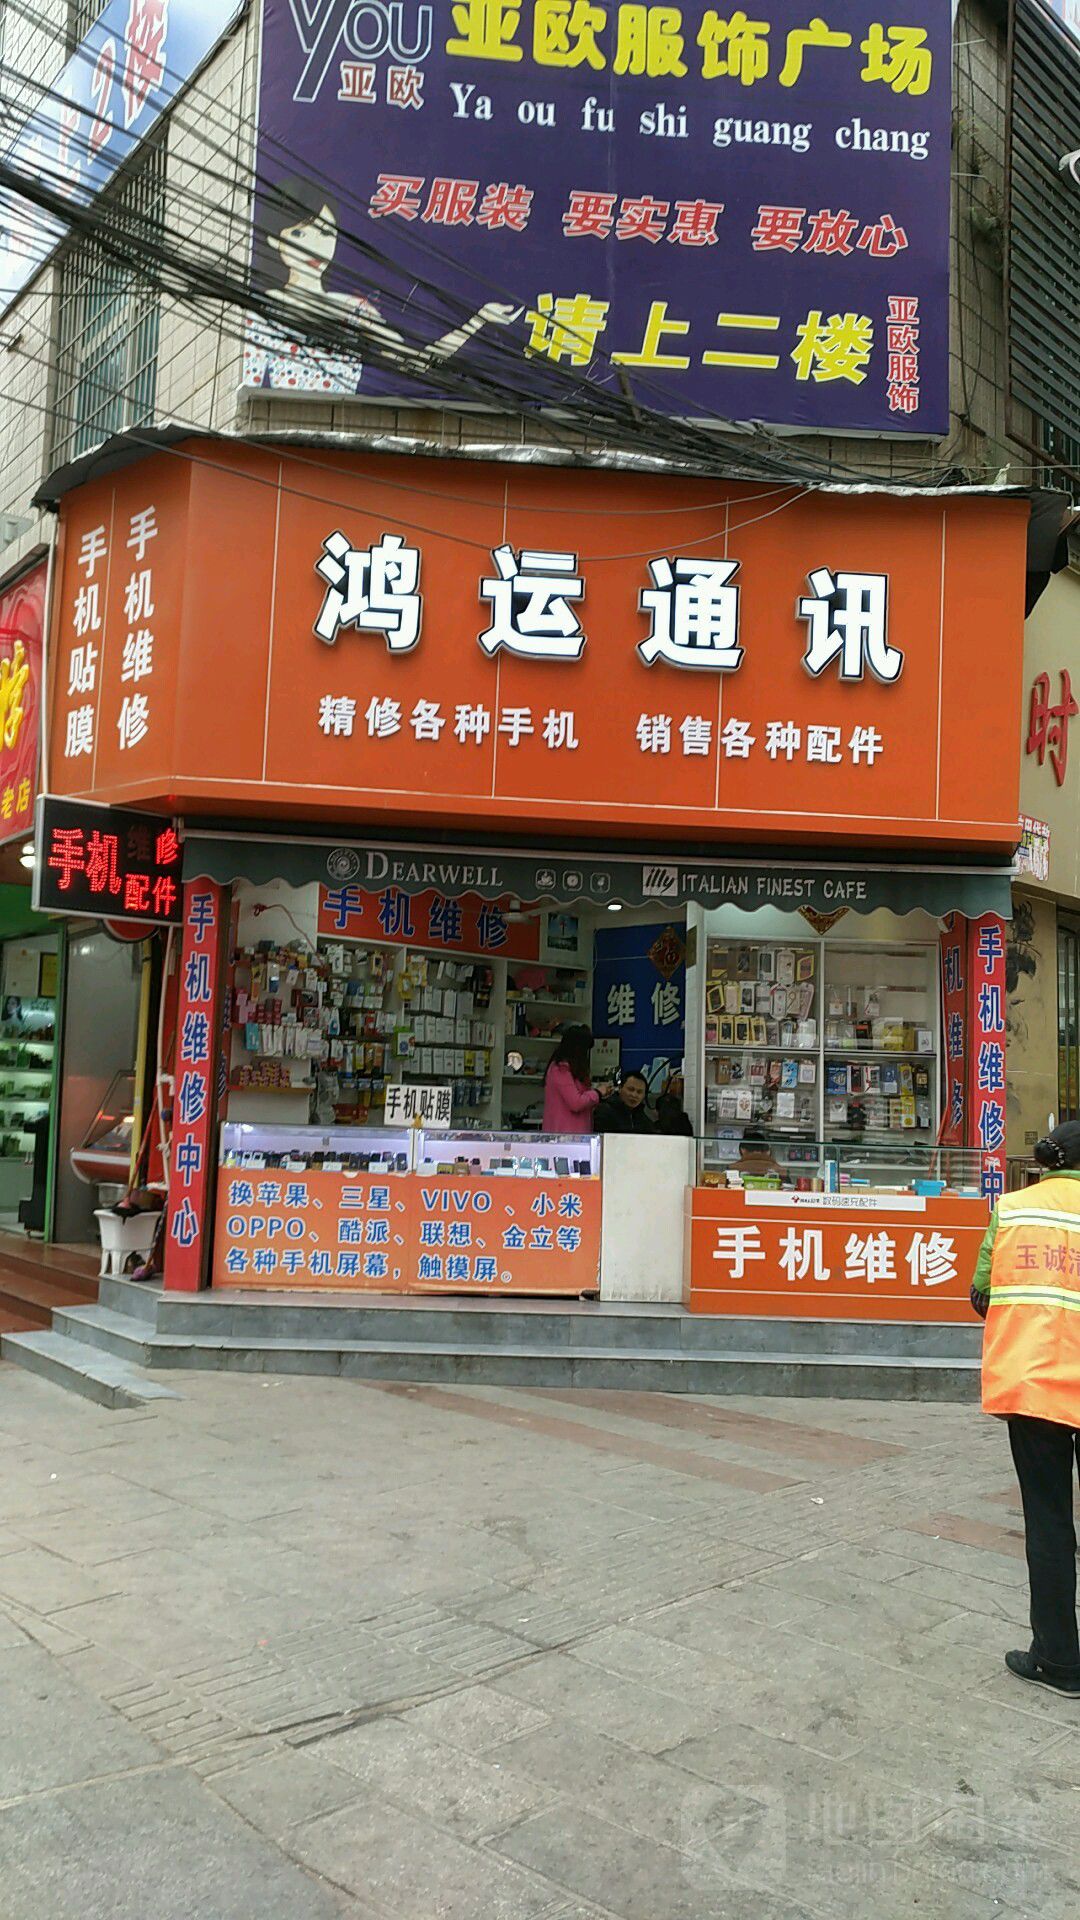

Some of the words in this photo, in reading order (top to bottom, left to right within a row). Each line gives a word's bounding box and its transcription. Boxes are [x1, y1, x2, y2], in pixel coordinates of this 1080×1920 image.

[446, 0, 933, 96] 亚欧服饰广场
[338, 60, 424, 109] 亚欧
[449, 82, 493, 121] Ya
[517, 99, 556, 128] ou
[581, 97, 615, 133] fu
[639, 104, 689, 138] shi
[713, 116, 811, 153] guang
[835, 119, 930, 159] chang
[370, 173, 534, 230] 买服装
[561, 191, 723, 246] 要实惠
[752, 205, 908, 258] 要放心
[524, 293, 875, 385] 请上二楼
[886, 296, 919, 413] 亚欧服饰
[64, 525, 108, 758] 手机贴膜
[117, 505, 158, 751] 手机维修
[312, 529, 904, 684] 鸿运通讯
[319, 694, 579, 750] 精修各种手机
[636, 713, 884, 766] 销售各种配件
[1027, 668, 1079, 787] 时
[48, 827, 122, 896] 手机
[123, 873, 177, 916] 配件
[365, 851, 503, 888] DEARWELL
[643, 867, 677, 896] illy
[682, 877, 749, 895] ITALIAN
[757, 878, 815, 898] FINEST
[823, 880, 867, 900] CAFE
[324, 884, 510, 949] 手机维修
[607, 981, 682, 1027] 维修
[171, 894, 216, 1248] 手机维修中心
[385, 1086, 452, 1122] 手机贴膜
[712, 1225, 958, 1286] 手机维修
